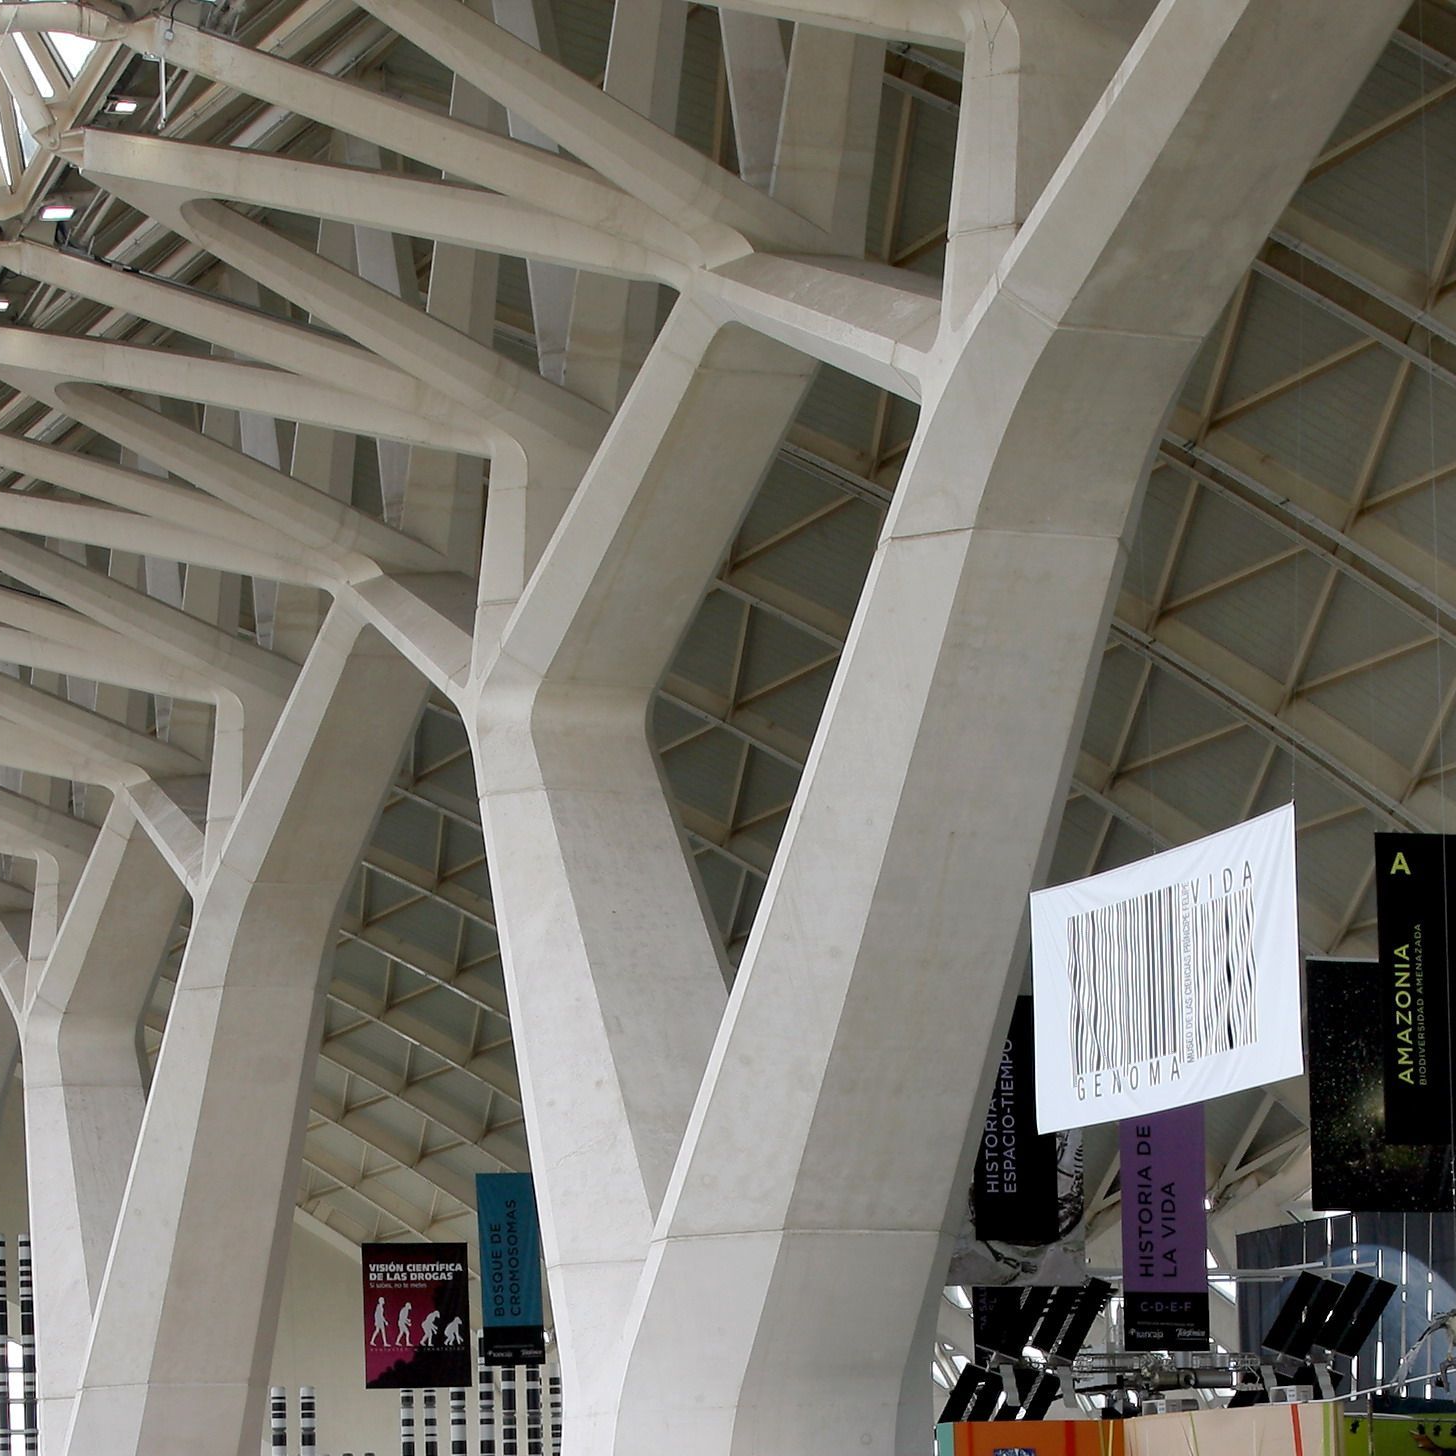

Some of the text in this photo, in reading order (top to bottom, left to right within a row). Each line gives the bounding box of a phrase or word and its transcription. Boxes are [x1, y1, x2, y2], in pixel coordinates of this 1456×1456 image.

[1191, 860, 1253, 903] VIDA
[1390, 851, 1412, 875] A
[1183, 954, 1193, 995] CIENCIAS
[1184, 997, 1193, 1015] LAS
[1185, 1015, 1193, 1030] DE
[1393, 943, 1415, 1085] AMAZONIA
[1414, 923, 1427, 1086] BIODIVERSIDAD AMENAZADA
[1186, 1032, 1195, 1063] MUSEO
[1077, 1056, 1181, 1102] GENOMA
[1000, 1039, 1017, 1193] ESPACIO-TIEMPO
[985, 1098, 1000, 1193] HISTORIA
[1136, 1124, 1154, 1278] HISTORIA DE
[1160, 1181, 1178, 1278] LA VIDA
[369, 1261, 463, 1272] VISIÓN CIENTÍFICA
[369, 1271, 454, 1281] DE LAS DROGAS
[489, 1223, 505, 1318] BOSQUE DE
[505, 1199, 521, 1318] CROMOSOMAS
[1140, 1301, 1192, 1313] C-D-E-F
